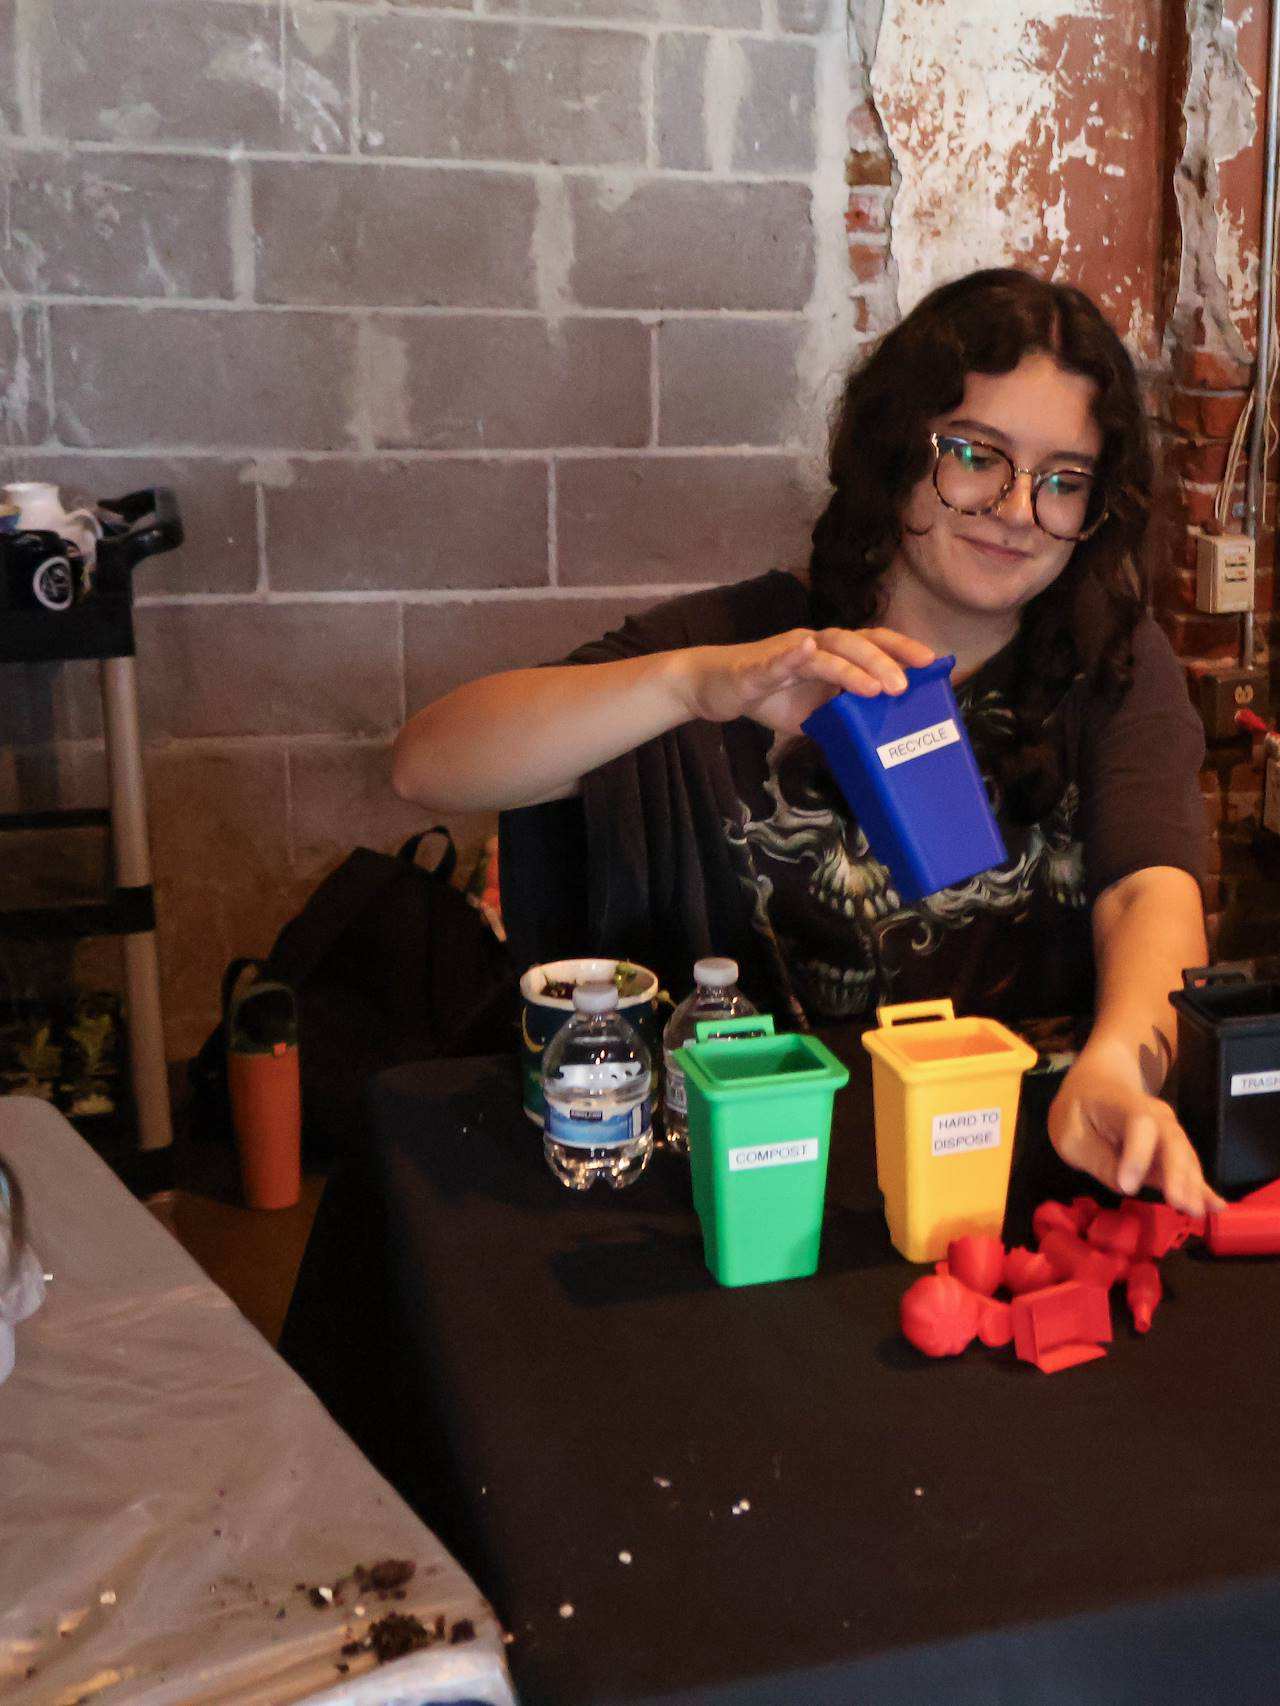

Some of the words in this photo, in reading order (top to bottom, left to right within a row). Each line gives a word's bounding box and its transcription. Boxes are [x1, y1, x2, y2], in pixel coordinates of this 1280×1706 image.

[888, 727, 948, 760] RECYCLE
[939, 1115, 977, 1129] HARD
[981, 1111, 999, 1124] TO
[934, 1131, 991, 1151] DISPOSE
[735, 1144, 807, 1164] COMPOST
